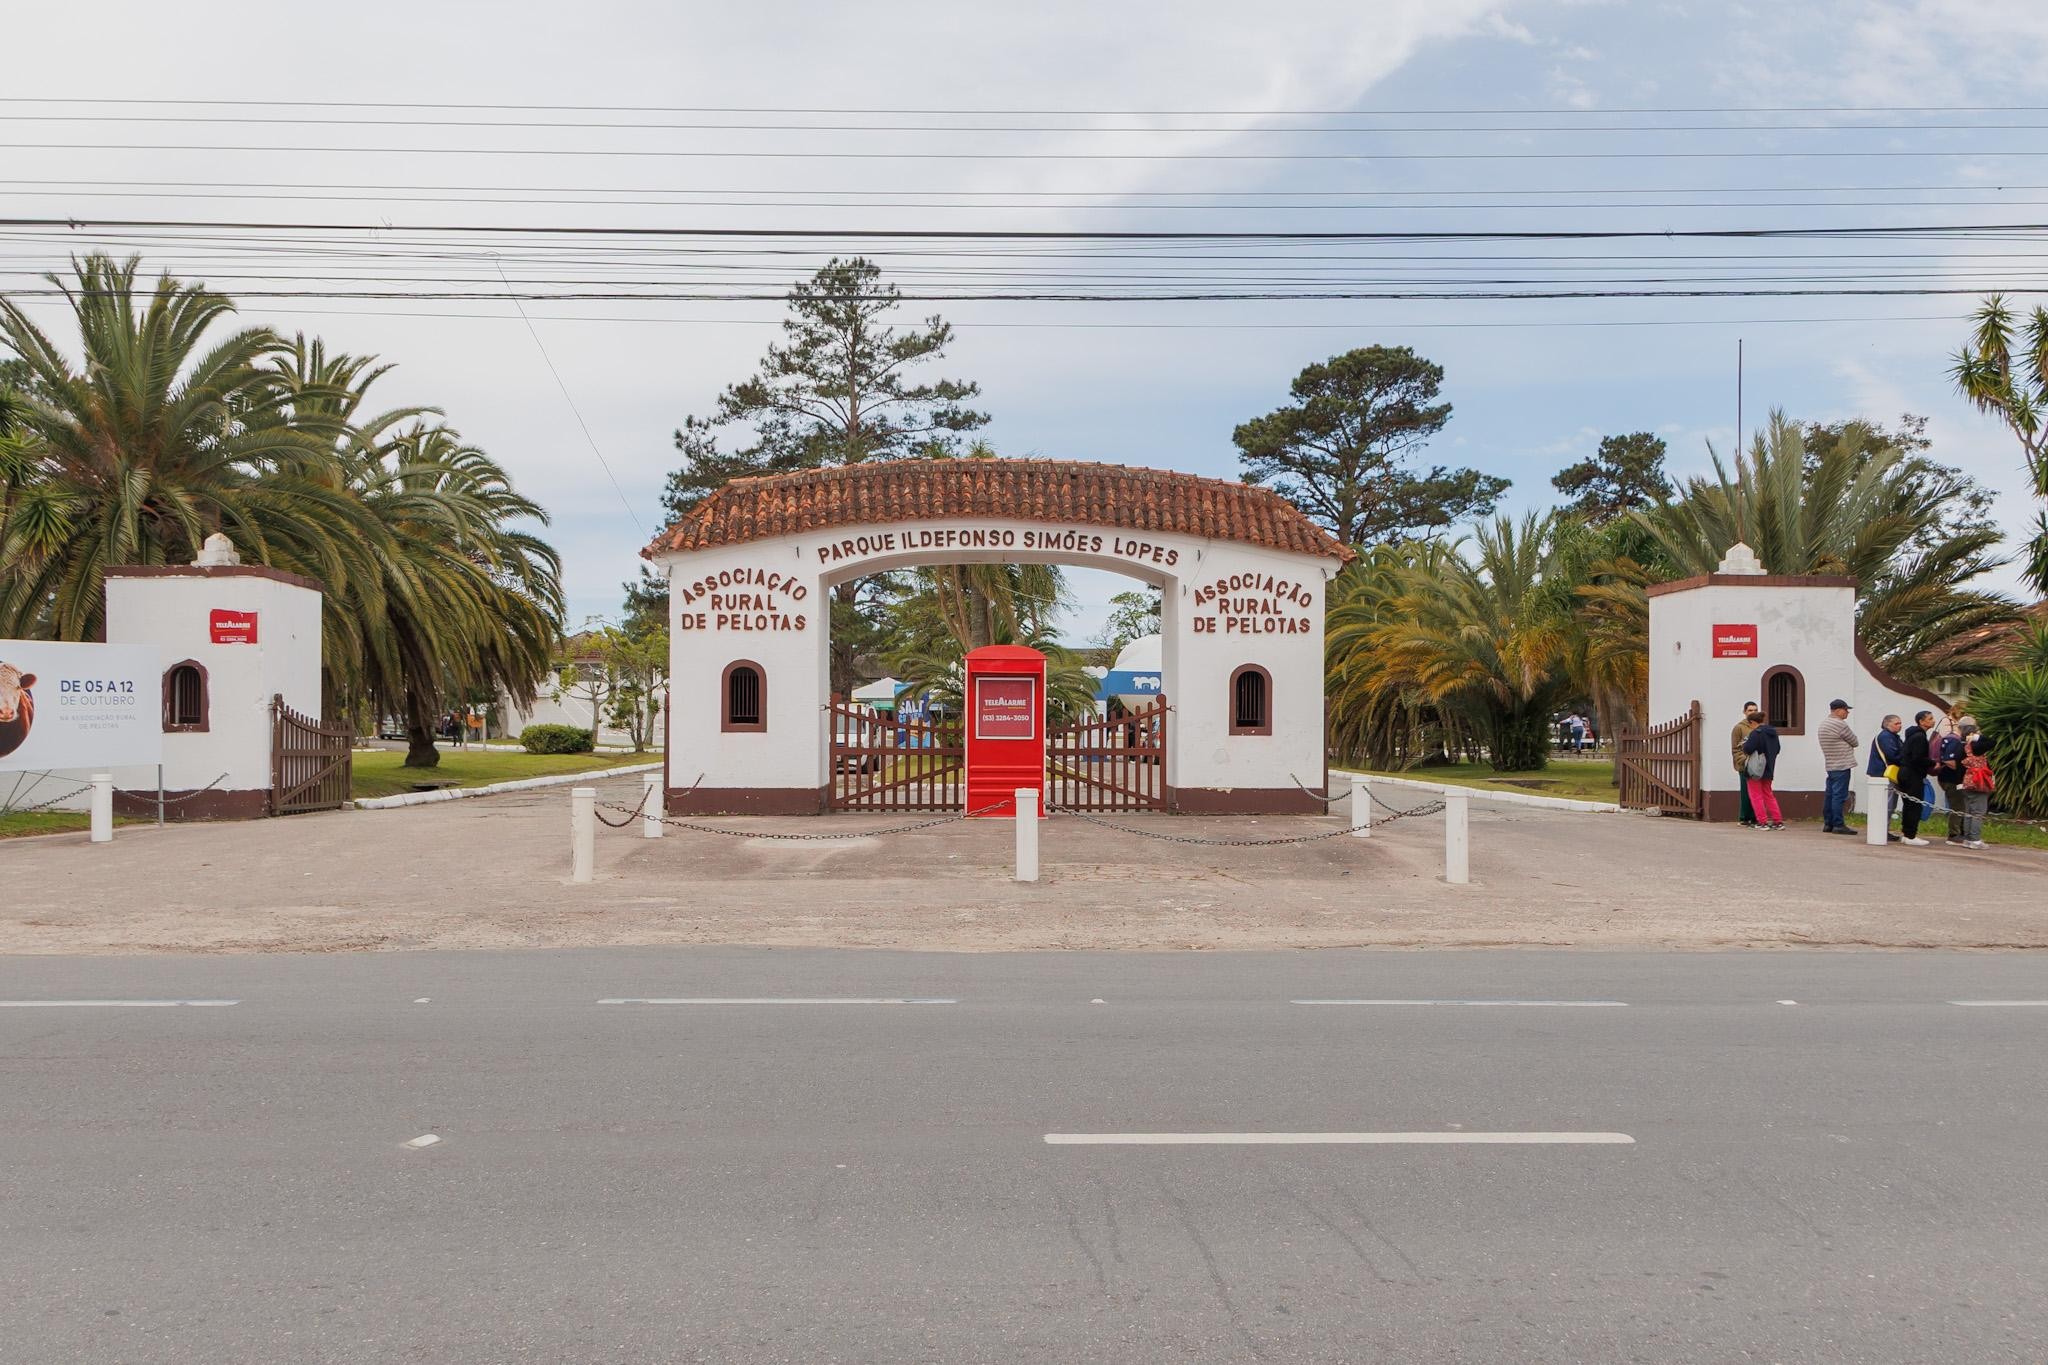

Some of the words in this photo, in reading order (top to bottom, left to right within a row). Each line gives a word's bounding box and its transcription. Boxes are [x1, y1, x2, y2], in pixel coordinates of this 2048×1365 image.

[818, 533, 895, 564] PARQUE
[902, 529, 1015, 549] ILDEFONSO
[1024, 530, 1103, 552] SIMÕES
[1114, 537, 1179, 566] LOPES
[682, 568, 807, 605] ASSOCIAÇÃO
[1194, 573, 1312, 608] ASSOCIAÇÃO
[711, 594, 777, 611] RURAL
[1219, 598, 1283, 614] RURAL
[682, 613, 706, 630] DE
[717, 614, 806, 631] PELOTAS
[1193, 617, 1216, 633] DE
[1226, 616, 1311, 634] PELOTAS
[60, 680, 81, 692] DE
[85, 680, 103, 692] 05
[106, 681, 117, 692] A
[120, 681, 133, 692] 12
[60, 696, 77, 705] DE
[80, 696, 135, 705] OUTUBRO
